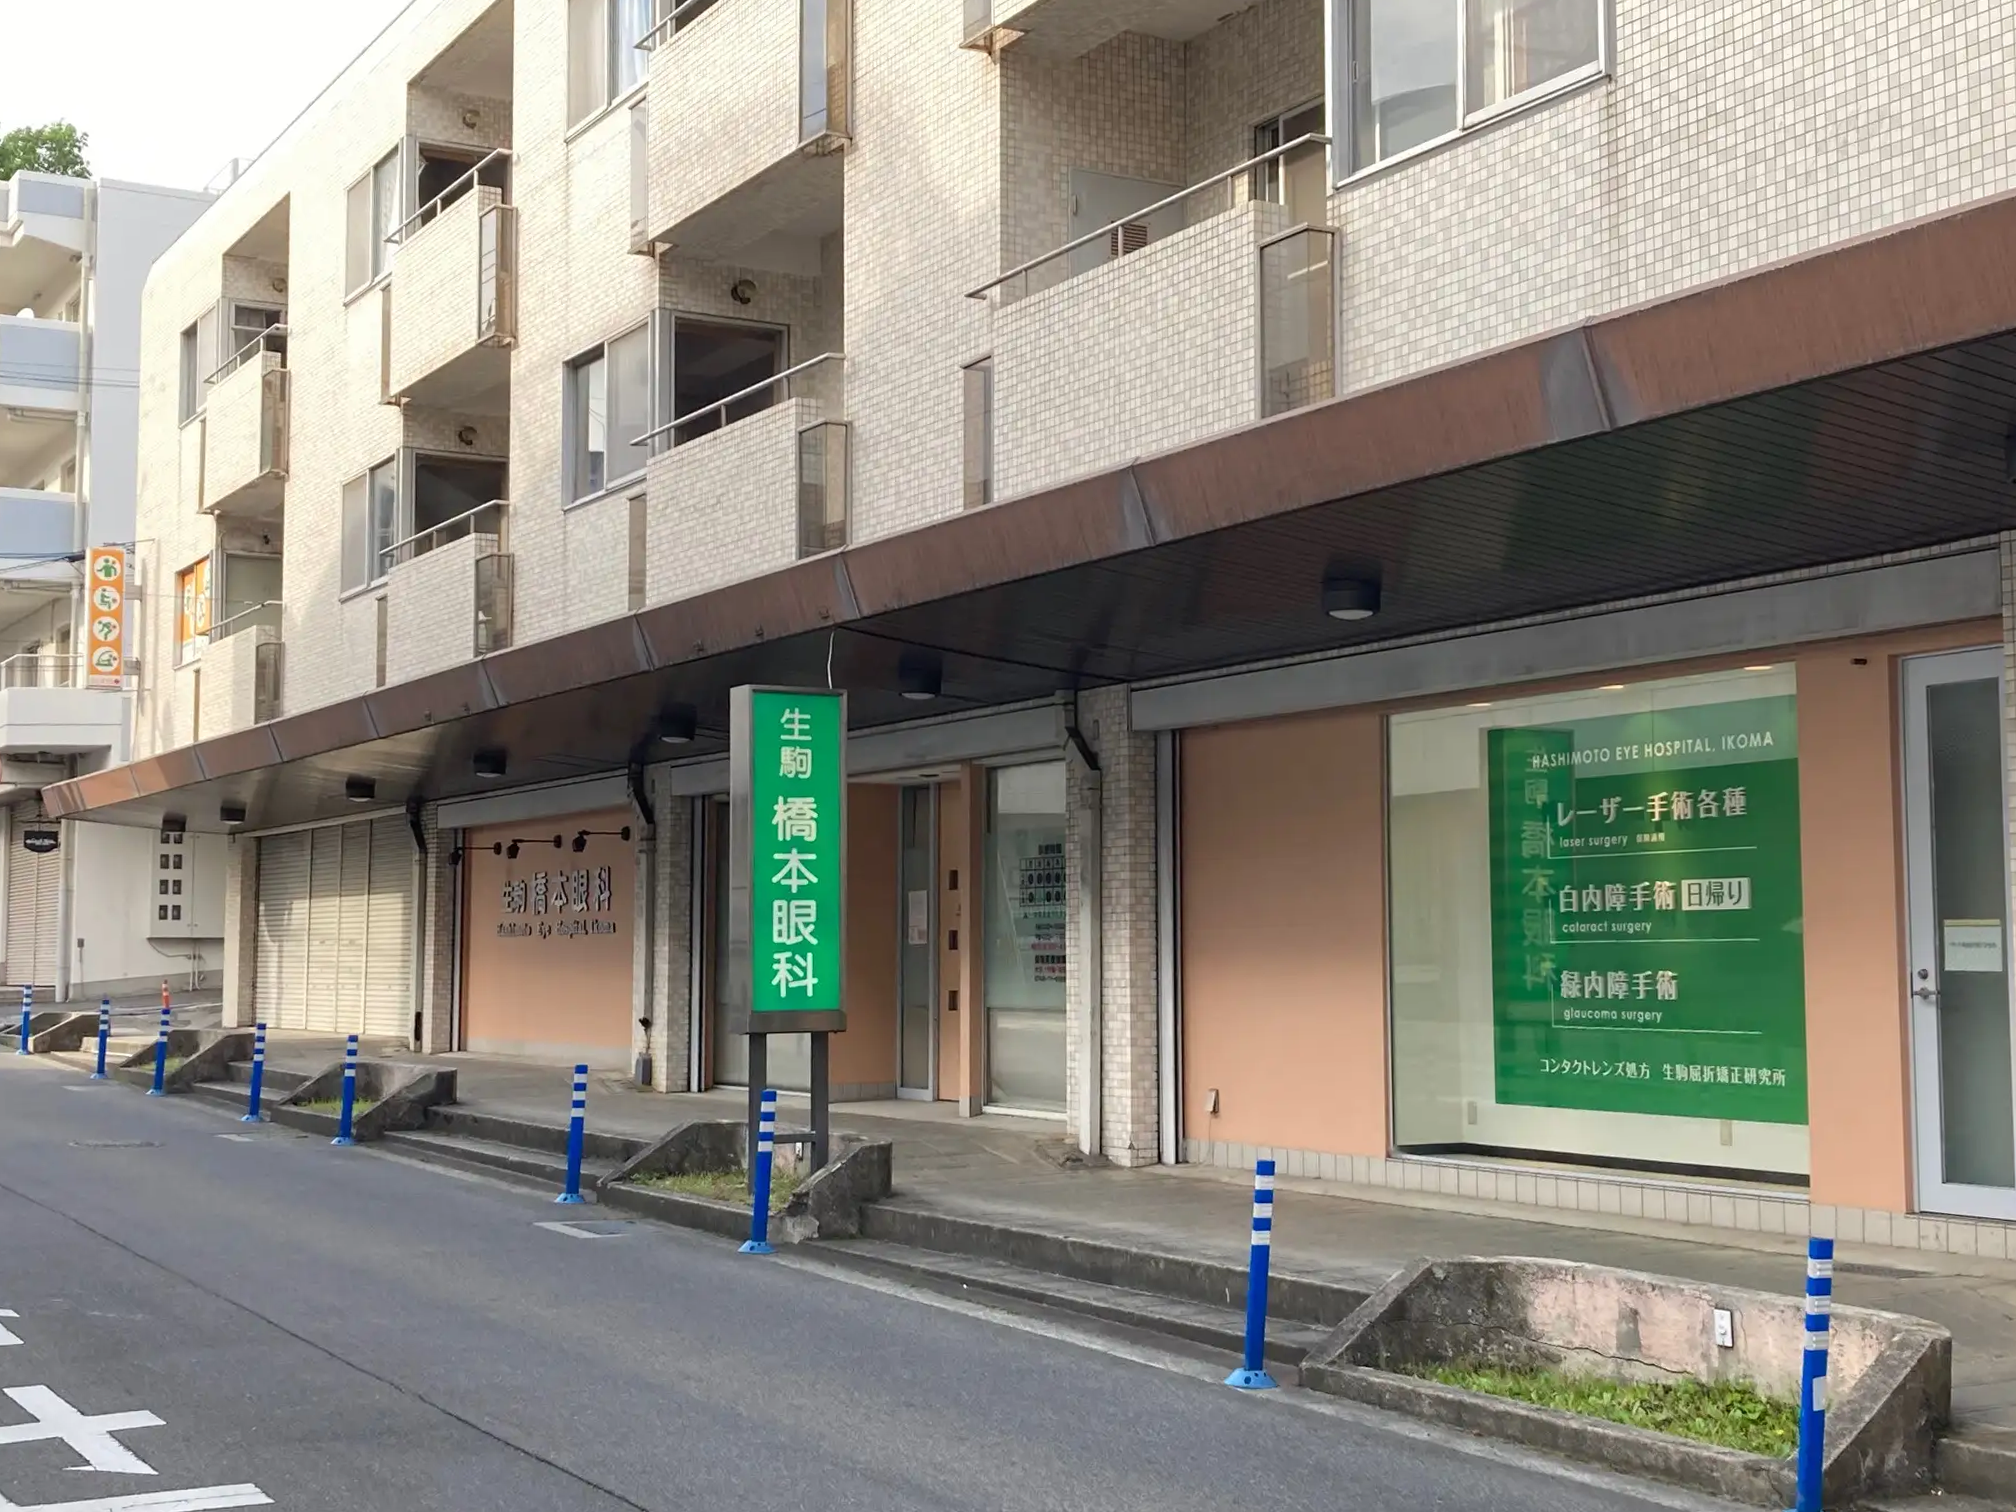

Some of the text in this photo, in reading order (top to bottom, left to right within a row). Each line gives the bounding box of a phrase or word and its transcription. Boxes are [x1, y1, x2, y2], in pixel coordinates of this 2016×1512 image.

[1532, 747, 1610, 769] HASHIMOTO
[1616, 745, 1639, 761] EYE
[1721, 732, 1774, 751] IKOMA
[1557, 787, 1747, 826] レーザー手術各種
[1560, 837, 1585, 848] laser
[1588, 835, 1628, 848] surgery
[771, 795, 818, 998] 橋本眼科
[1559, 880, 1743, 912] 白内障手術 日帰り
[1562, 921, 1652, 934] cataract surgery
[1560, 970, 1679, 1000] 緑内障手術
[1563, 1006, 1663, 1023] glaucoma surgery
[1540, 1058, 1786, 1087] コンタクトレンズ処方 生駒屈折矯正研究所
